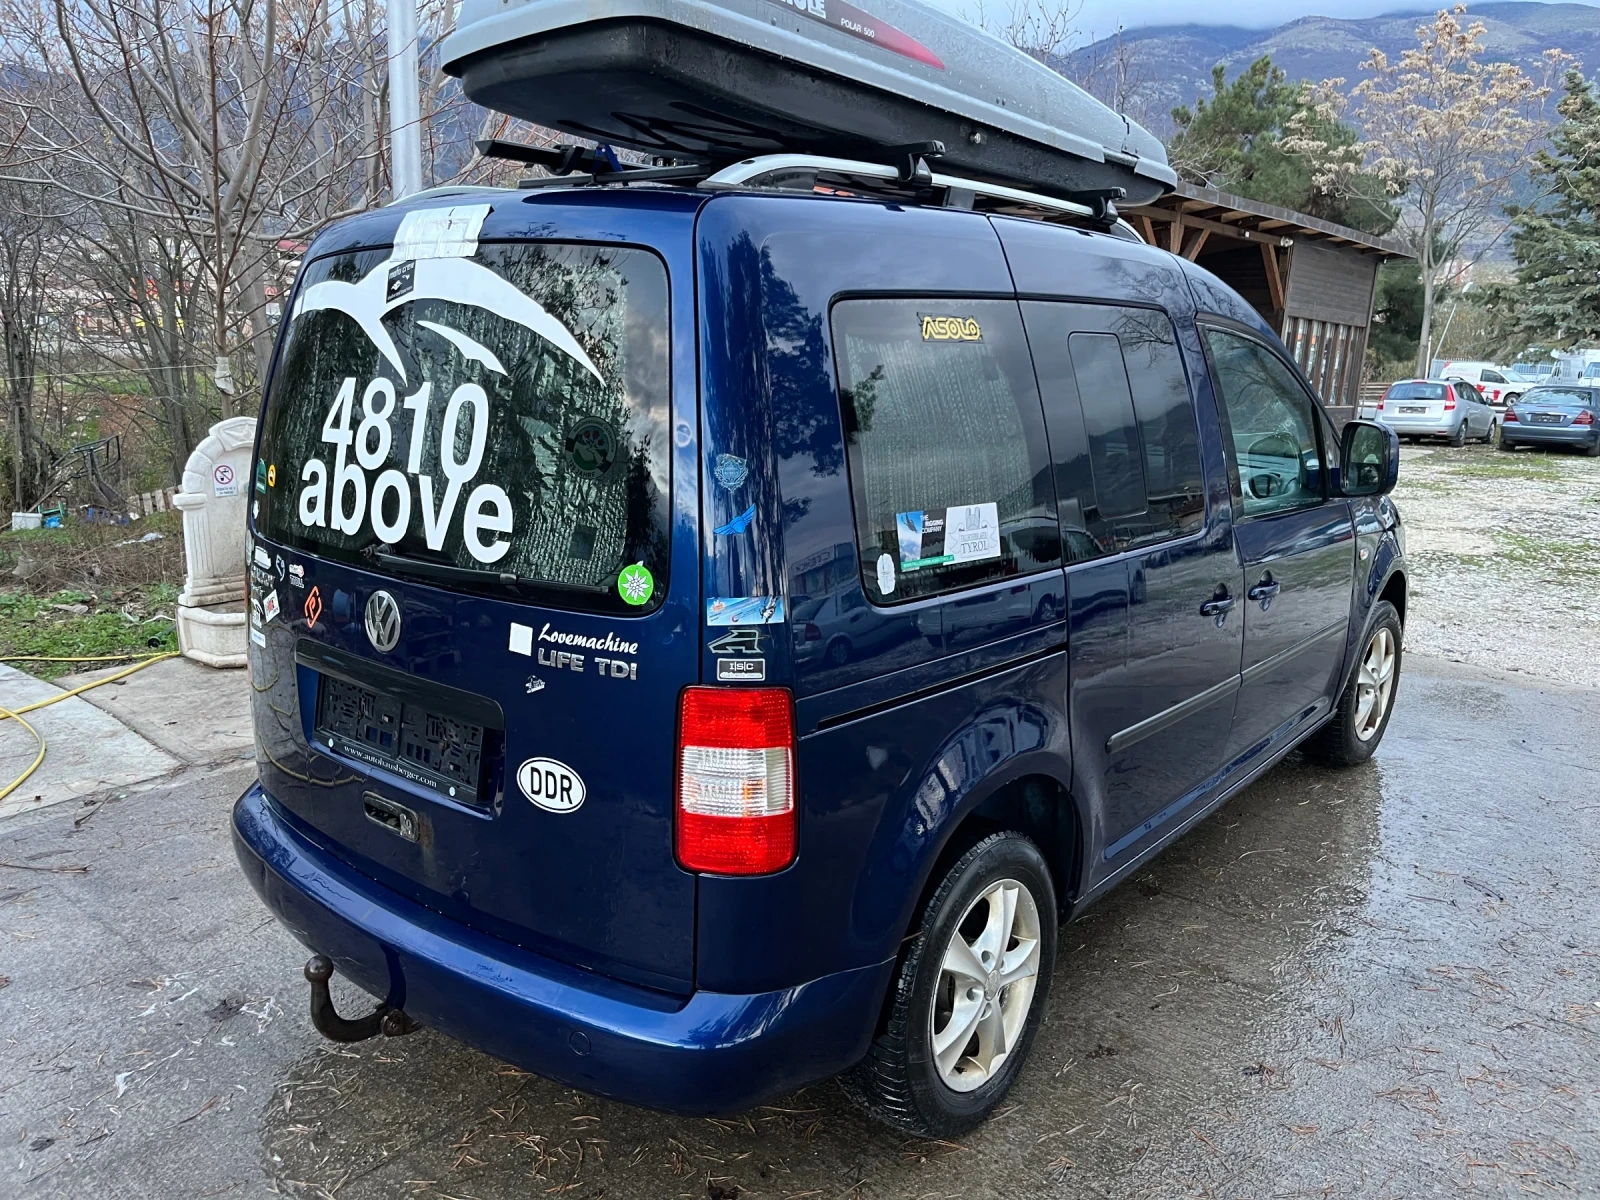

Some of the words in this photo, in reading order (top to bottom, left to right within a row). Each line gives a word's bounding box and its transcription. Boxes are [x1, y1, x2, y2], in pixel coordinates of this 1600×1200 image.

[840, 17, 862, 33] POLAR
[863, 27, 875, 38] 500
[923, 316, 981, 340] ASOLO
[321, 376, 489, 484] 4810
[575, 468, 596, 478] JAHRE
[299, 443, 514, 563] above
[922, 526, 942, 534] COMPANY
[961, 540, 988, 553] TYROL
[537, 622, 639, 654] Lovemachine
[537, 647, 585, 673] LIFE
[594, 656, 638, 681] TDI
[343, 744, 437, 788] www.autohausberger.com
[529, 766, 574, 805] DDR
